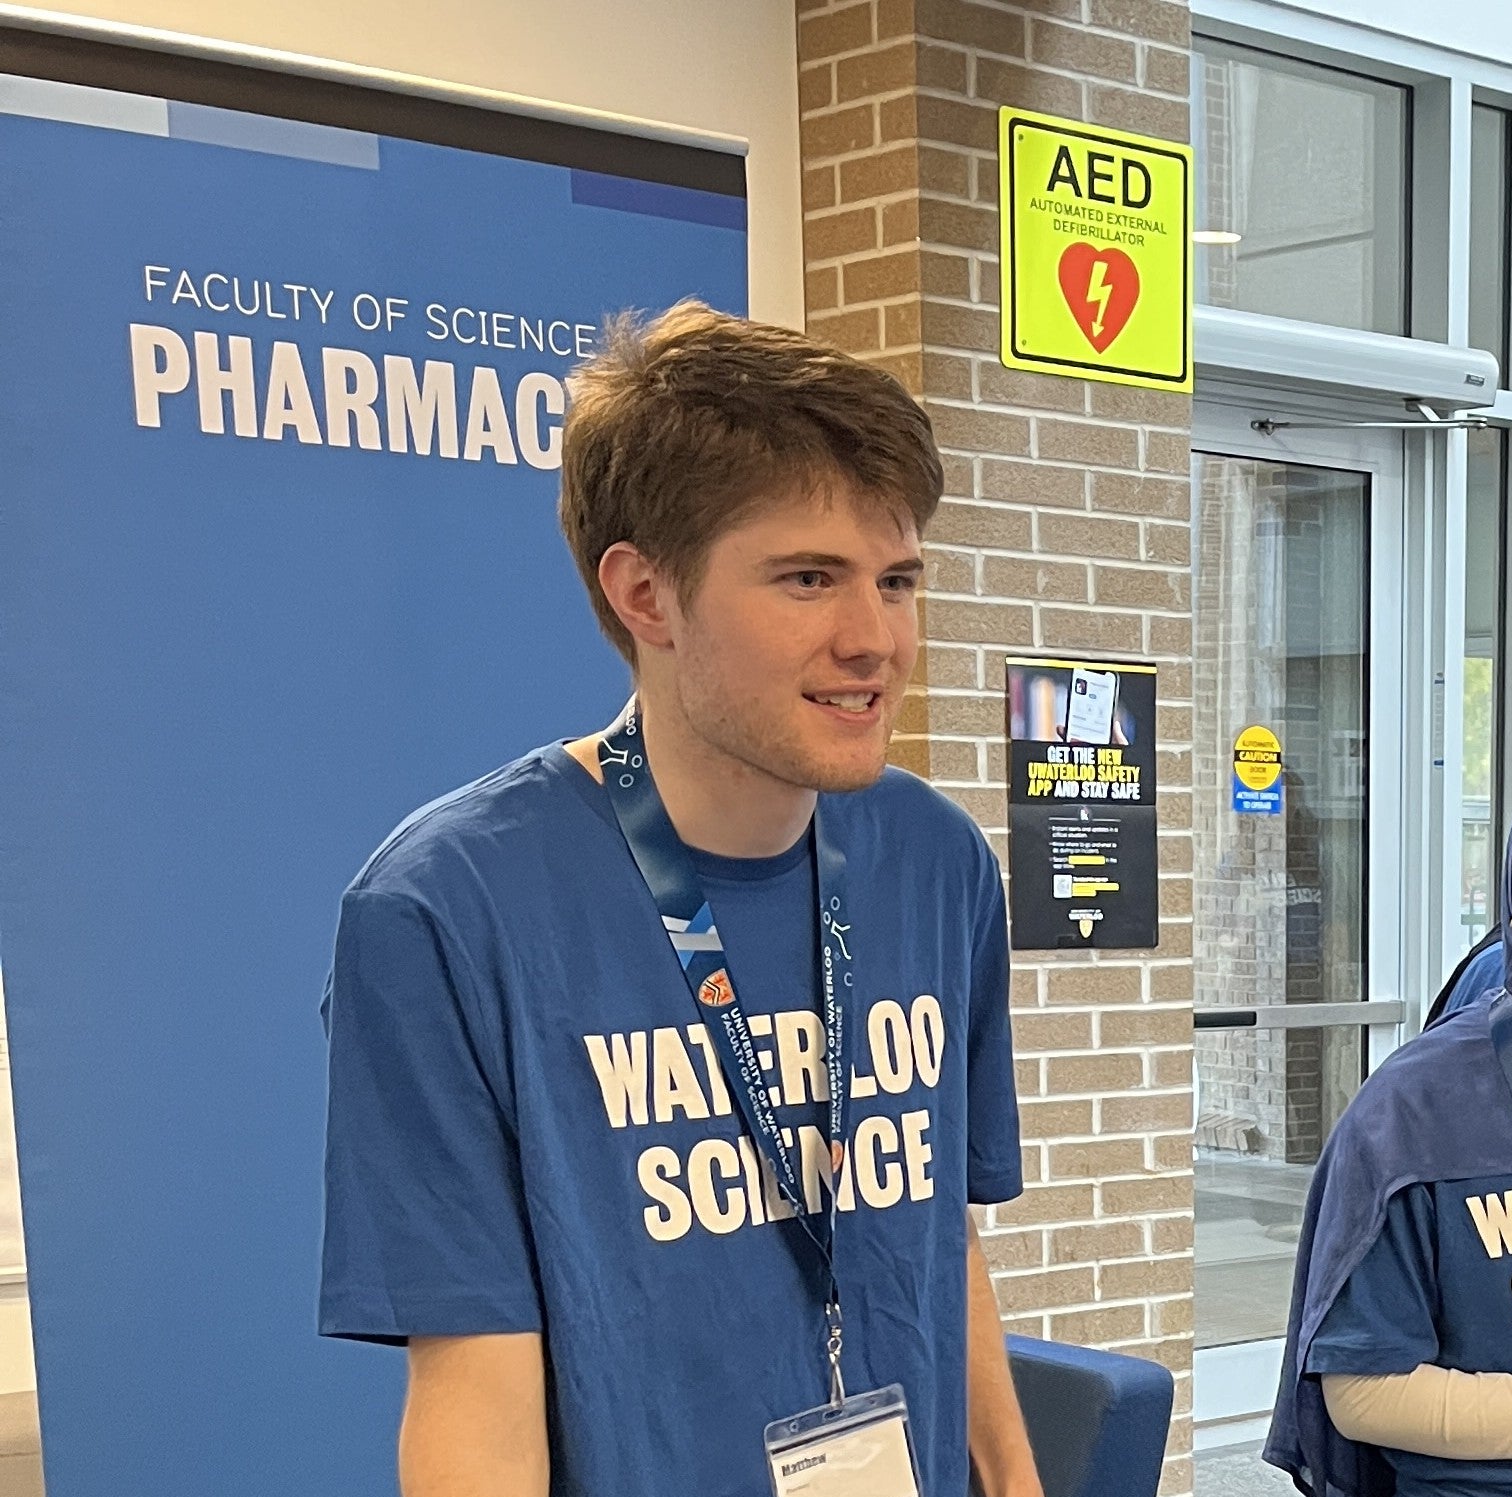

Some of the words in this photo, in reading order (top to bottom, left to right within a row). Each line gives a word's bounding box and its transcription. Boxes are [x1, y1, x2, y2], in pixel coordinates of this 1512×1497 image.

[1046, 145, 1152, 209] AED
[1029, 197, 1104, 224] AUTOMATED
[1107, 212, 1168, 235] EXTERNAL
[1053, 218, 1145, 247] DEFIBRILLATOR
[143, 265, 336, 325] FACULTY
[352, 293, 410, 334] OF
[426, 304, 598, 359] SCIENCE
[129, 323, 576, 471] PHARMAC
[1027, 762, 1096, 781] UWATERLOO
[1097, 764, 1140, 783] SAFETY
[1047, 746, 1071, 763] GET
[1072, 747, 1096, 765] THE
[1097, 748, 1122, 766] NEW
[1239, 751, 1278, 762] CAUTION
[1027, 779, 1053, 797] APP
[1053, 780, 1080, 798] AND
[1080, 781, 1110, 799] STAY
[1110, 782, 1141, 801] SAFE
[823, 946, 836, 1026] WATERLOO
[828, 1028, 837, 1048] OF
[720, 1013, 746, 1065] FACULTY
[740, 1066, 751, 1084] OF
[747, 1085, 771, 1137] SCIENCE
[730, 1007, 762, 1086] UNIVERSITY
[756, 1088, 770, 1111] OF
[764, 1110, 795, 1184] WATERLOO
[781, 1453, 827, 1477] Matthew
